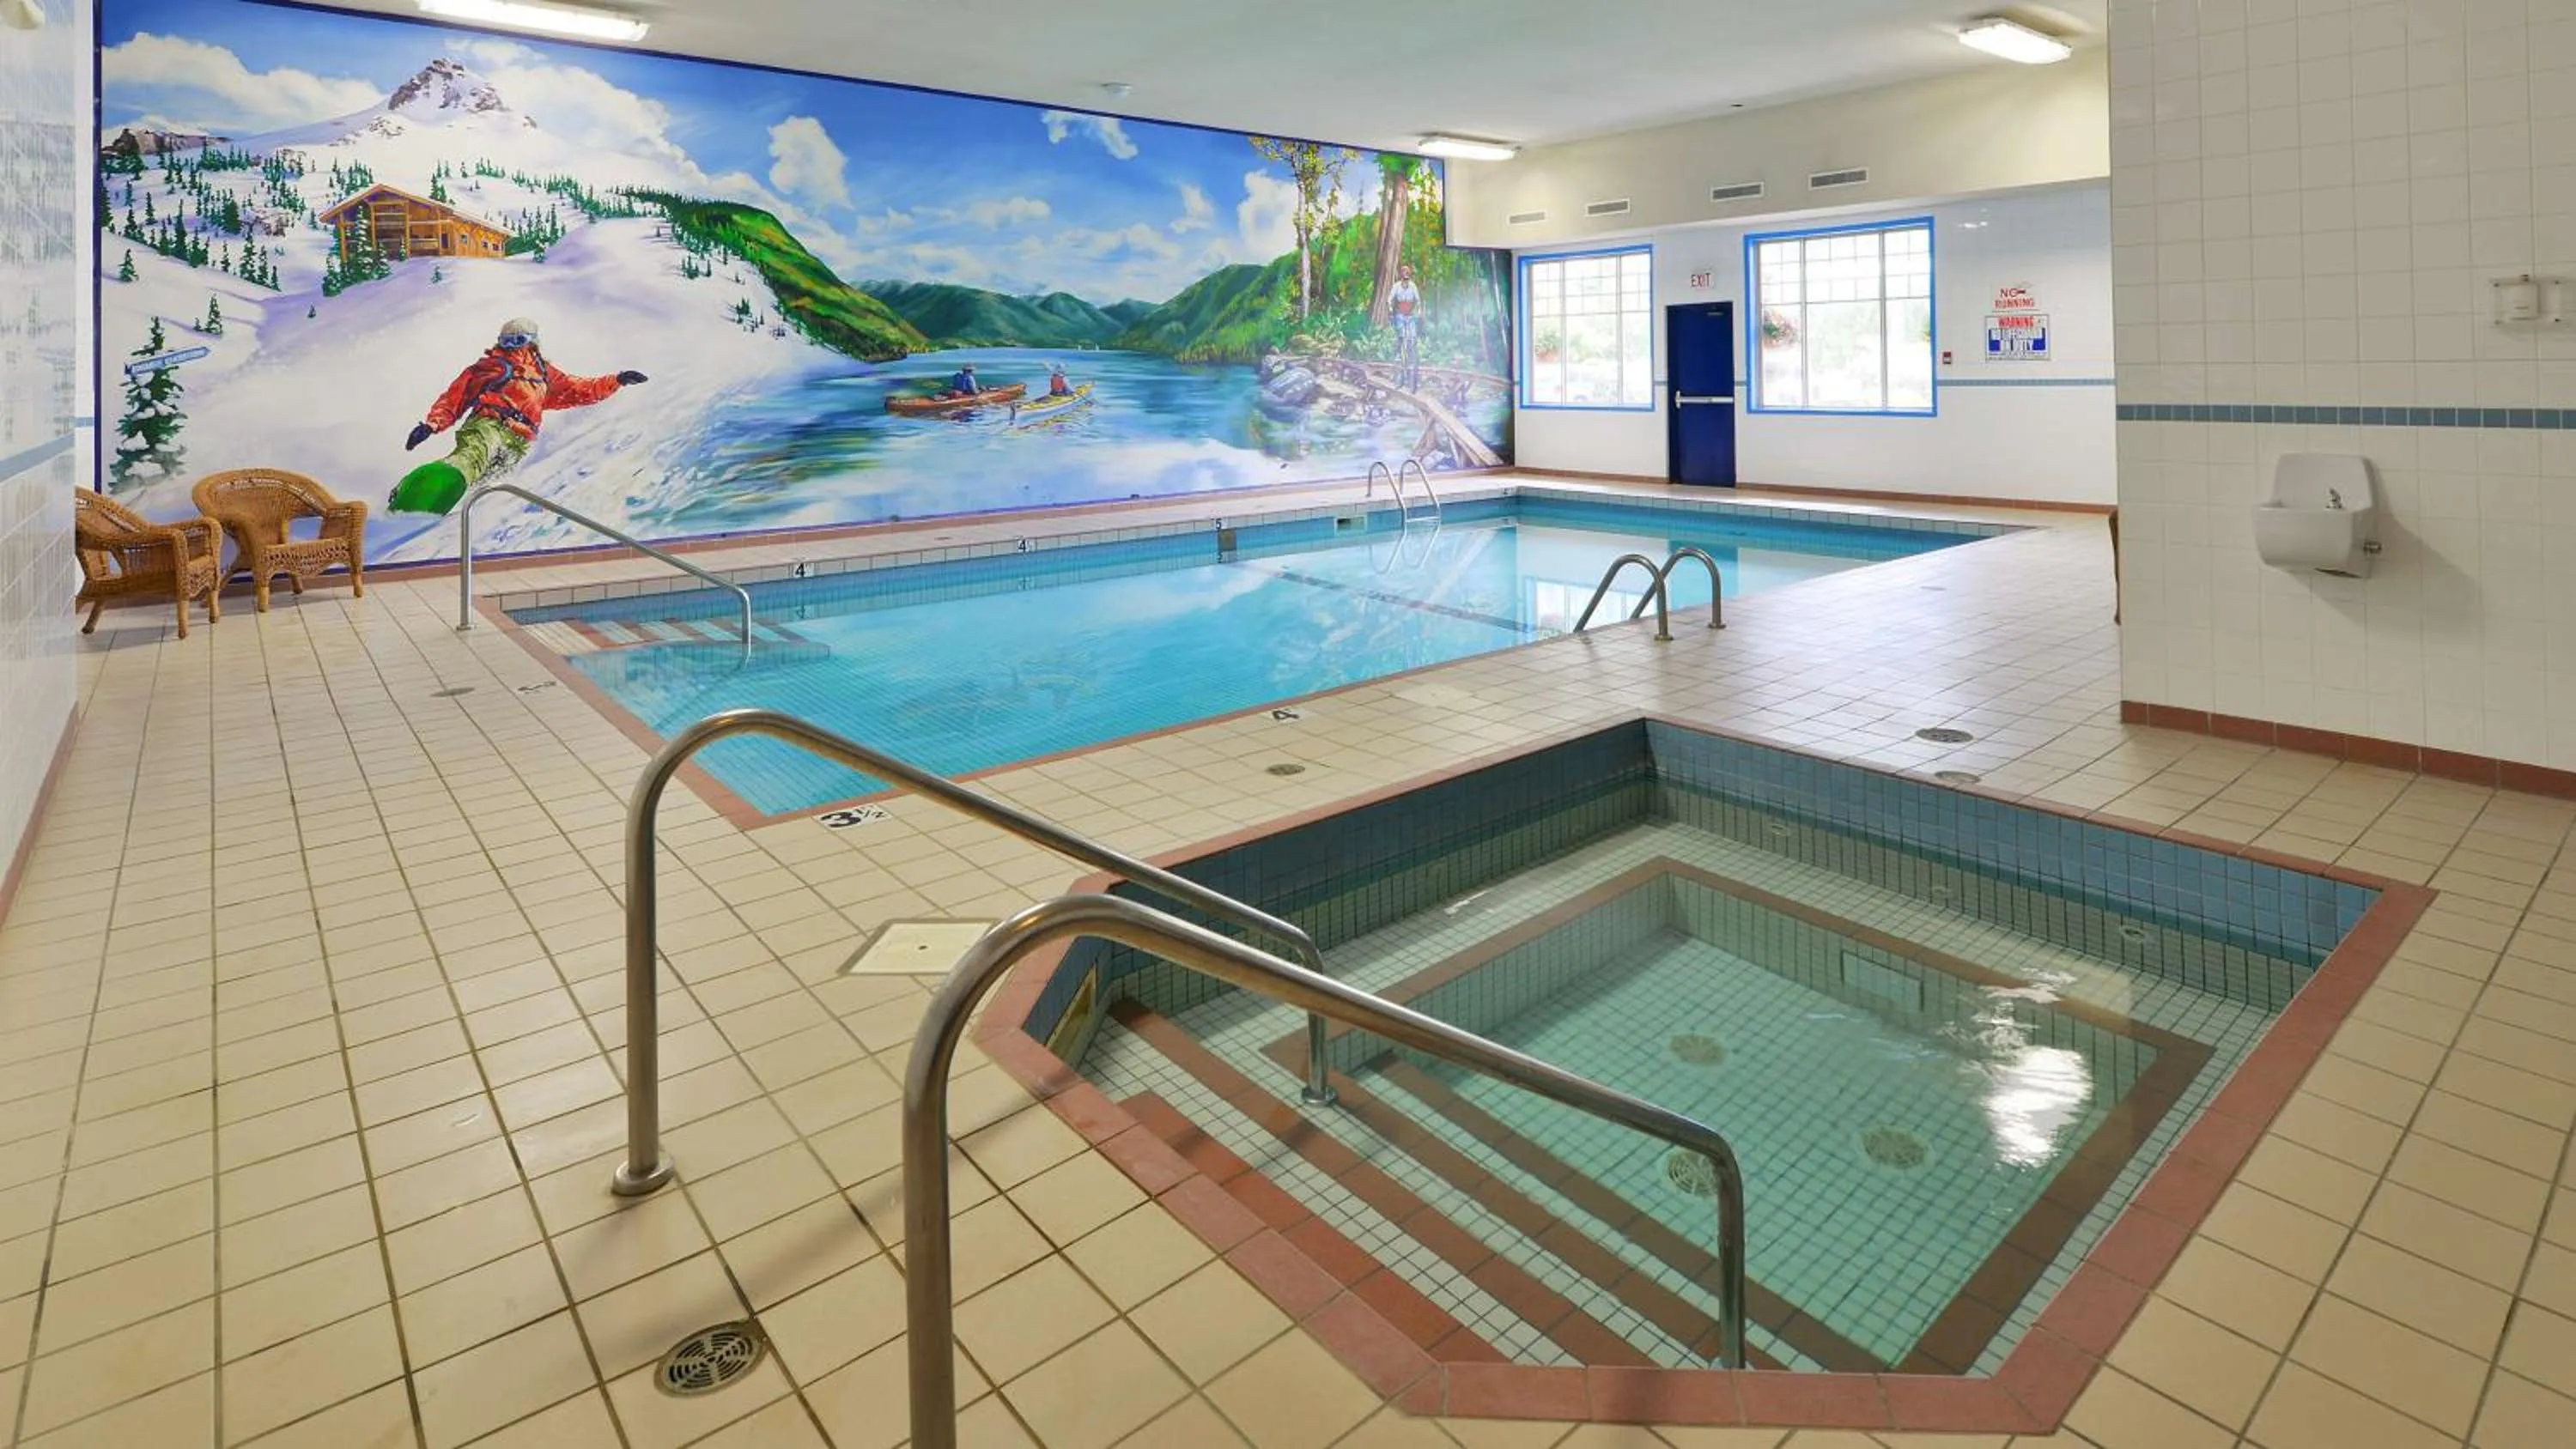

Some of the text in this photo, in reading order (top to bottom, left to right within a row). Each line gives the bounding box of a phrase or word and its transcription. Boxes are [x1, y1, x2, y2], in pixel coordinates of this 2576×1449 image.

[1691, 272, 1710, 287] EXIT
[2000, 288, 2018, 298] NO
[1018, 539, 1027, 553] 4
[795, 563, 805, 578] 4
[1272, 710, 1300, 721] 4
